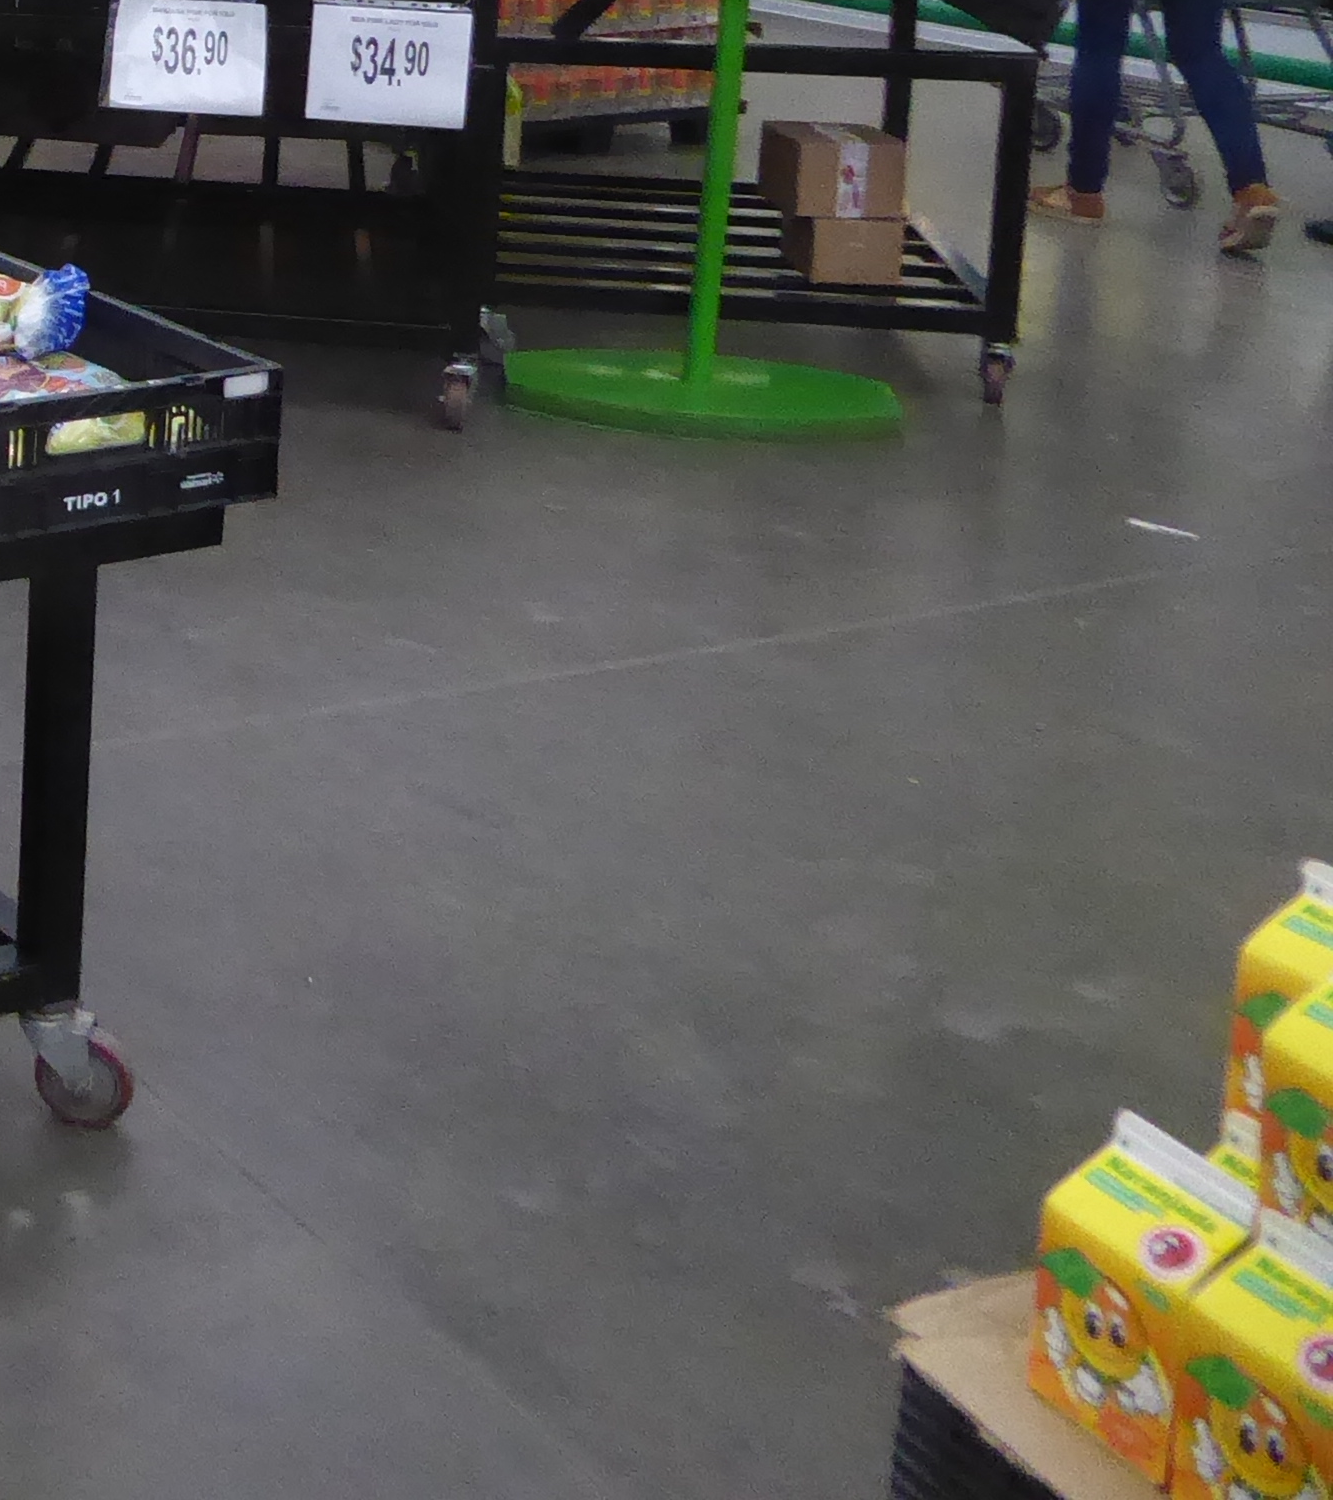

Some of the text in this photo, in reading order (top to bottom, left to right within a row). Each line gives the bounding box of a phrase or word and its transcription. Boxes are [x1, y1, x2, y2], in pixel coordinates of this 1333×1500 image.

[152, 24, 228, 75] $36.90
[350, 35, 429, 86] $34.90
[63, 488, 121, 512] TIPO 1
